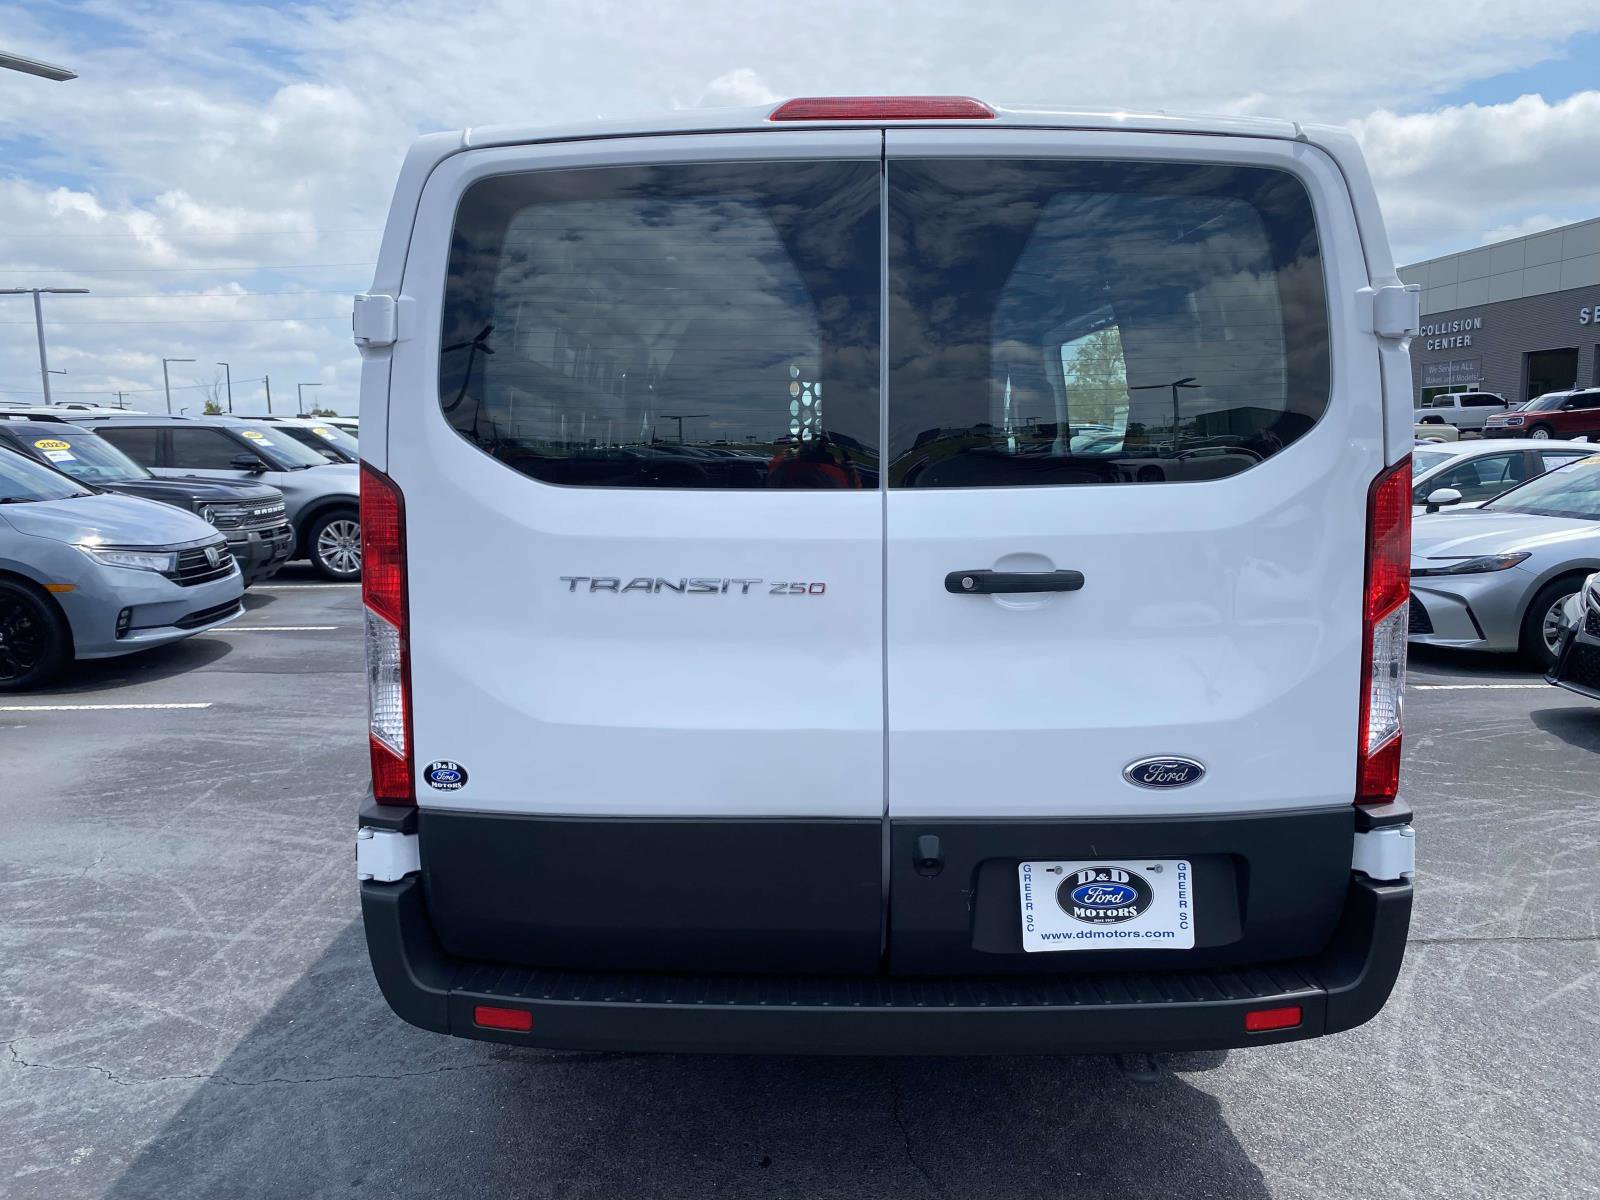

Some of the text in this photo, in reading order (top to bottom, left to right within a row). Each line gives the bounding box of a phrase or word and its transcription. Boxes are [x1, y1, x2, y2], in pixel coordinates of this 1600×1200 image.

[1420, 317, 1482, 337] COLLISION
[1427, 335, 1472, 351] CENTER
[559, 576, 826, 595] TRANSIT 250
[436, 771, 455, 781] Ford
[1143, 763, 1189, 782] Ford
[1076, 868, 1130, 885] D&D
[1023, 864, 1035, 933] GREER SC
[1084, 886, 1124, 904] Ford
[1177, 862, 1189, 930] GREER SC
[1073, 905, 1138, 918] MOTORS
[1041, 929, 1175, 941] www.ddmotors.com
